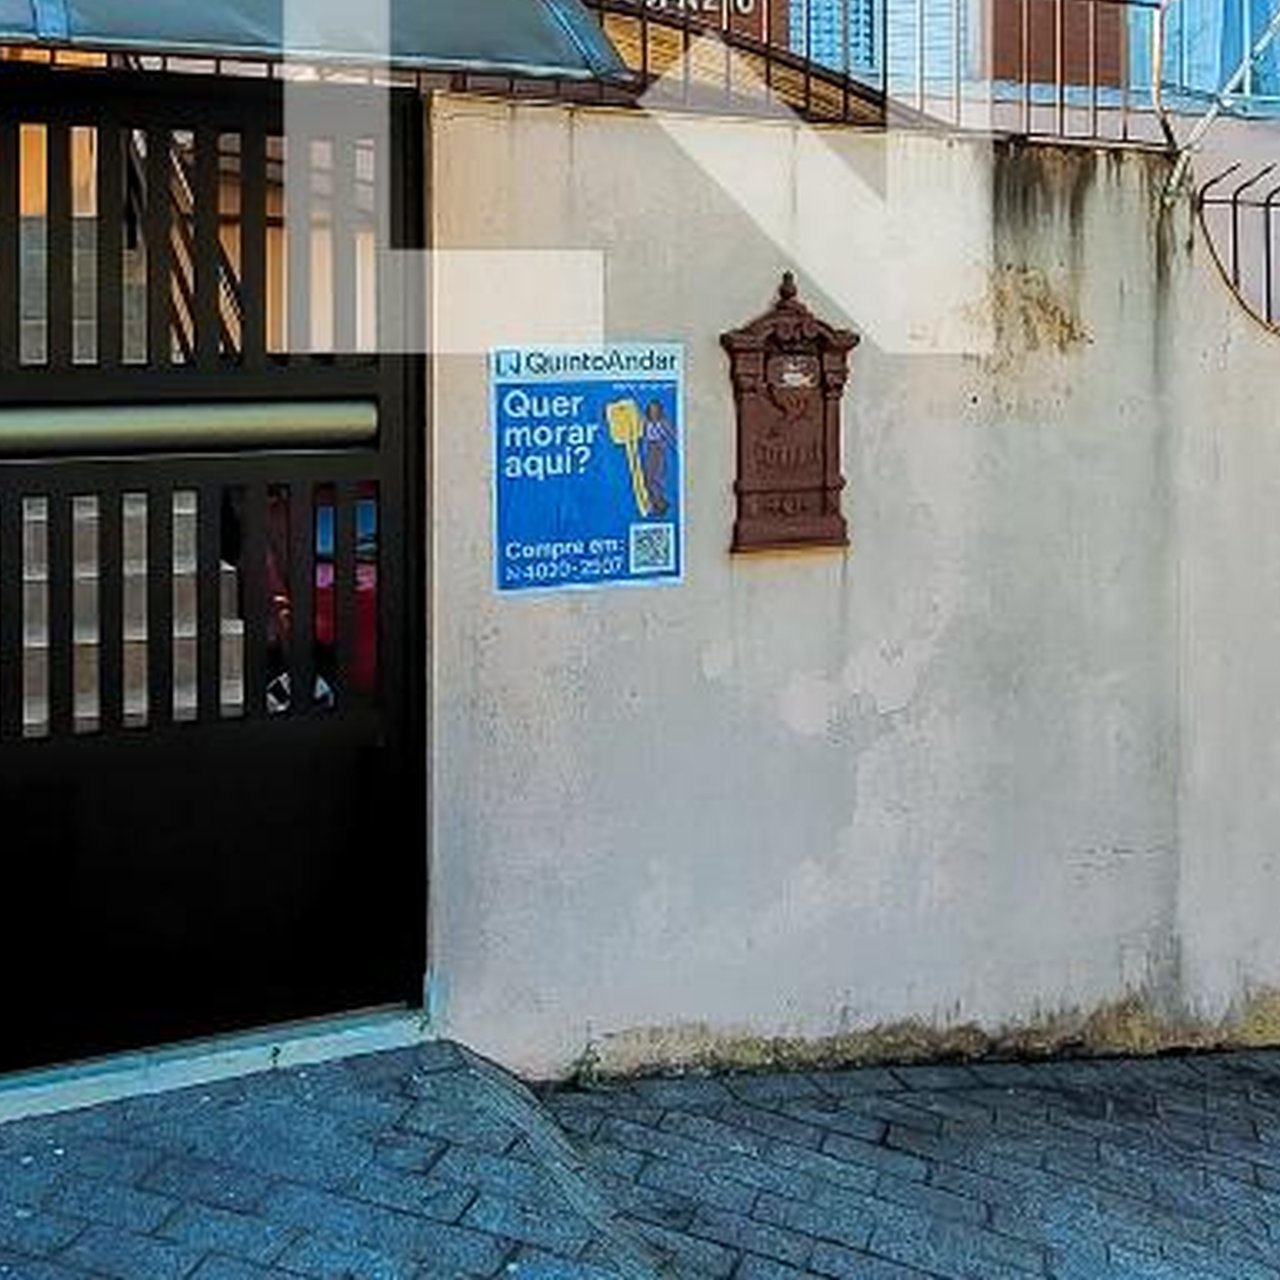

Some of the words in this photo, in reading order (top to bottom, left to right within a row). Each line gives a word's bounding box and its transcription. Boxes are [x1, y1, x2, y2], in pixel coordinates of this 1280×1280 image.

[525, 350, 676, 373] QuintoAndar
[503, 389, 584, 418] Quer
[504, 422, 598, 447] morar
[504, 445, 592, 480] aqui?
